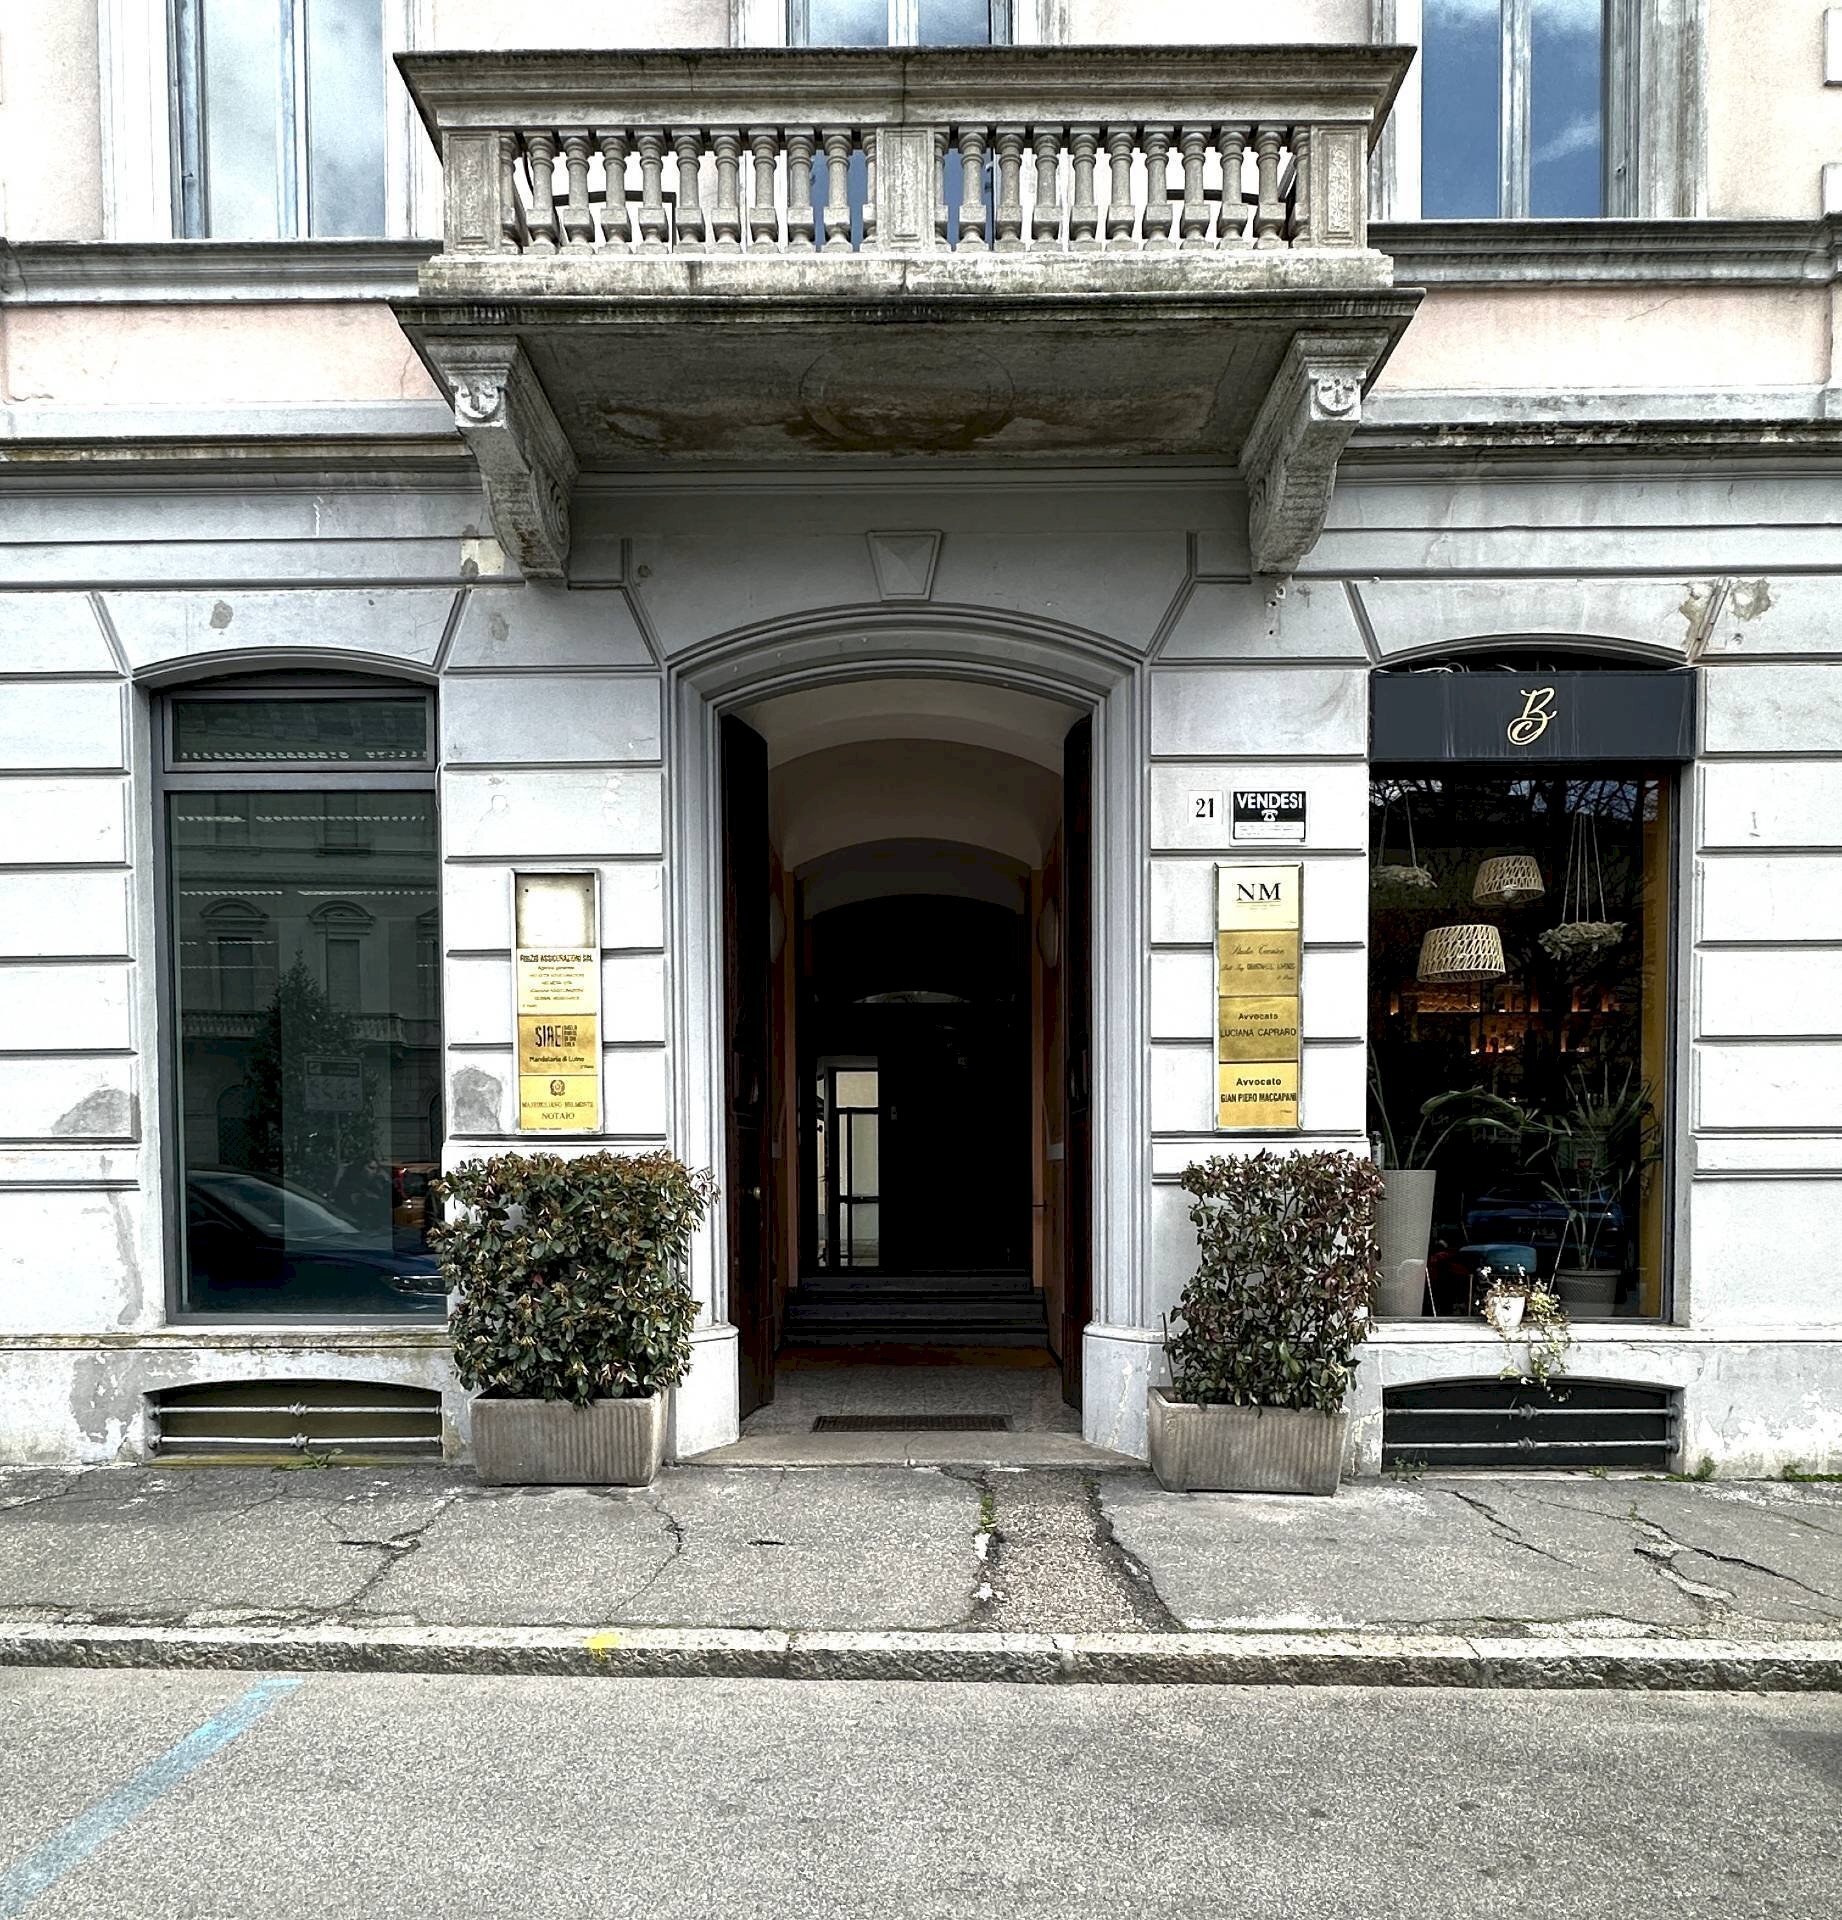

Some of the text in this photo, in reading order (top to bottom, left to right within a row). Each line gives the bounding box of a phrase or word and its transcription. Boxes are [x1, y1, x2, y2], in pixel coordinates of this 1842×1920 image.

[1236, 793, 1303, 809] VENDESI
[1195, 798, 1214, 818] 21
[1236, 882, 1282, 901] NM
[1238, 1012, 1279, 1021] Avvocato
[534, 1024, 562, 1048] SIAE
[1220, 1027, 1297, 1038] LUCIANA CAPRARO
[1235, 1077, 1282, 1087] Avvocato
[1220, 1093, 1237, 1103] GIAN
[1238, 1093, 1258, 1103] PIERO
[541, 1112, 576, 1120] NOTAIO
